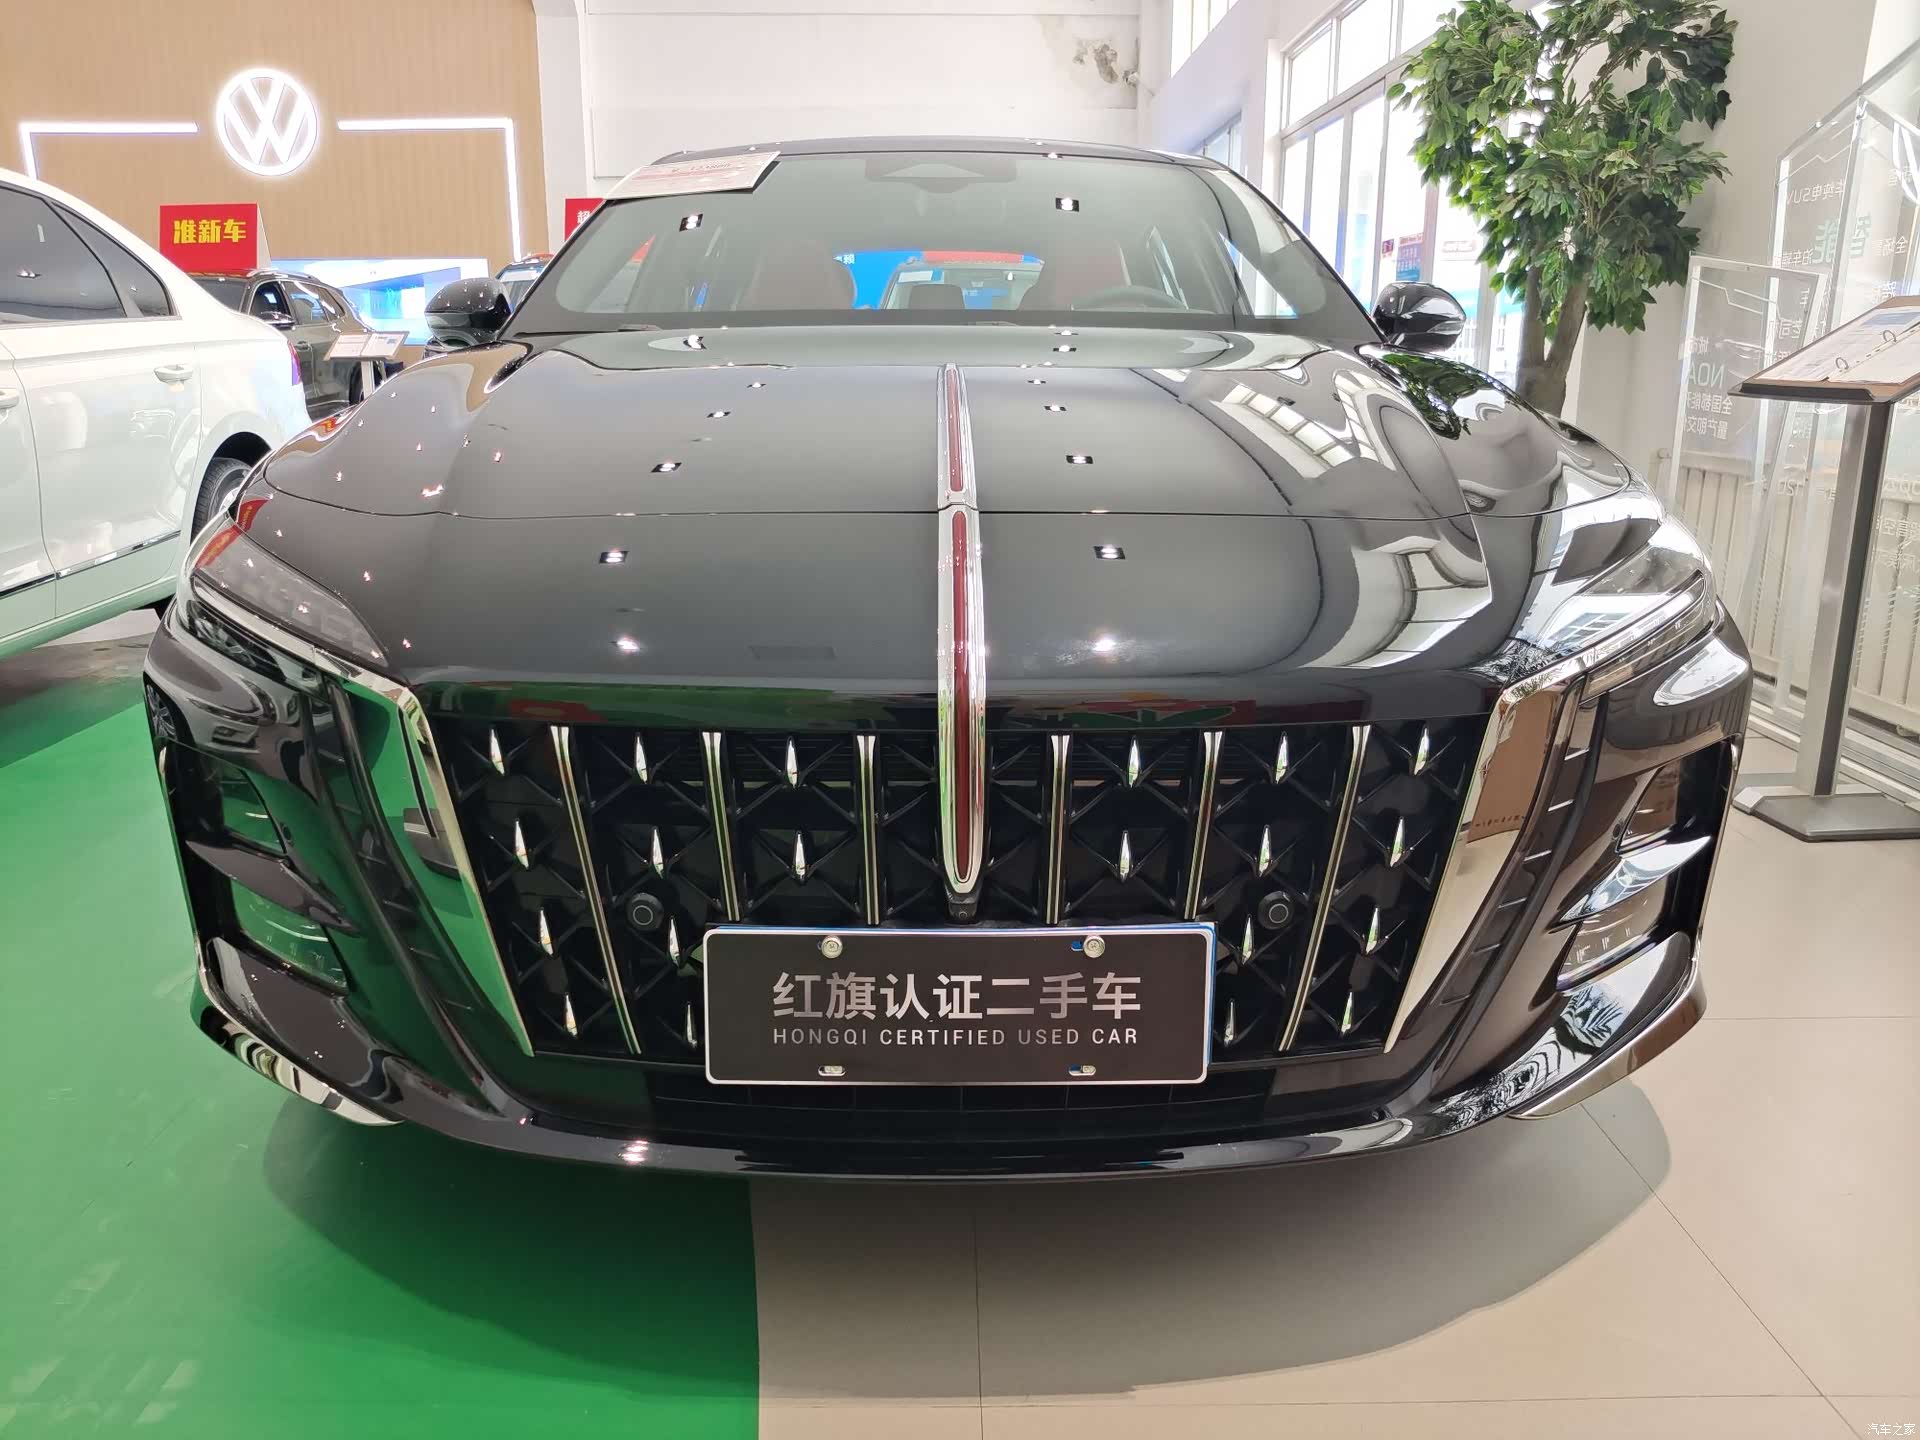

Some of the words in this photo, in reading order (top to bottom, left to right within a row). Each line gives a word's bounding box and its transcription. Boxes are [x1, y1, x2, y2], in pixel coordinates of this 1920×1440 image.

[772, 971, 1142, 1020] 红旗认证二手车
[772, 1028, 868, 1046] HONGQI
[879, 1028, 1006, 1045] CERTIFIED
[1018, 1028, 1080, 1044] USED
[1091, 1027, 1138, 1044] CAR
